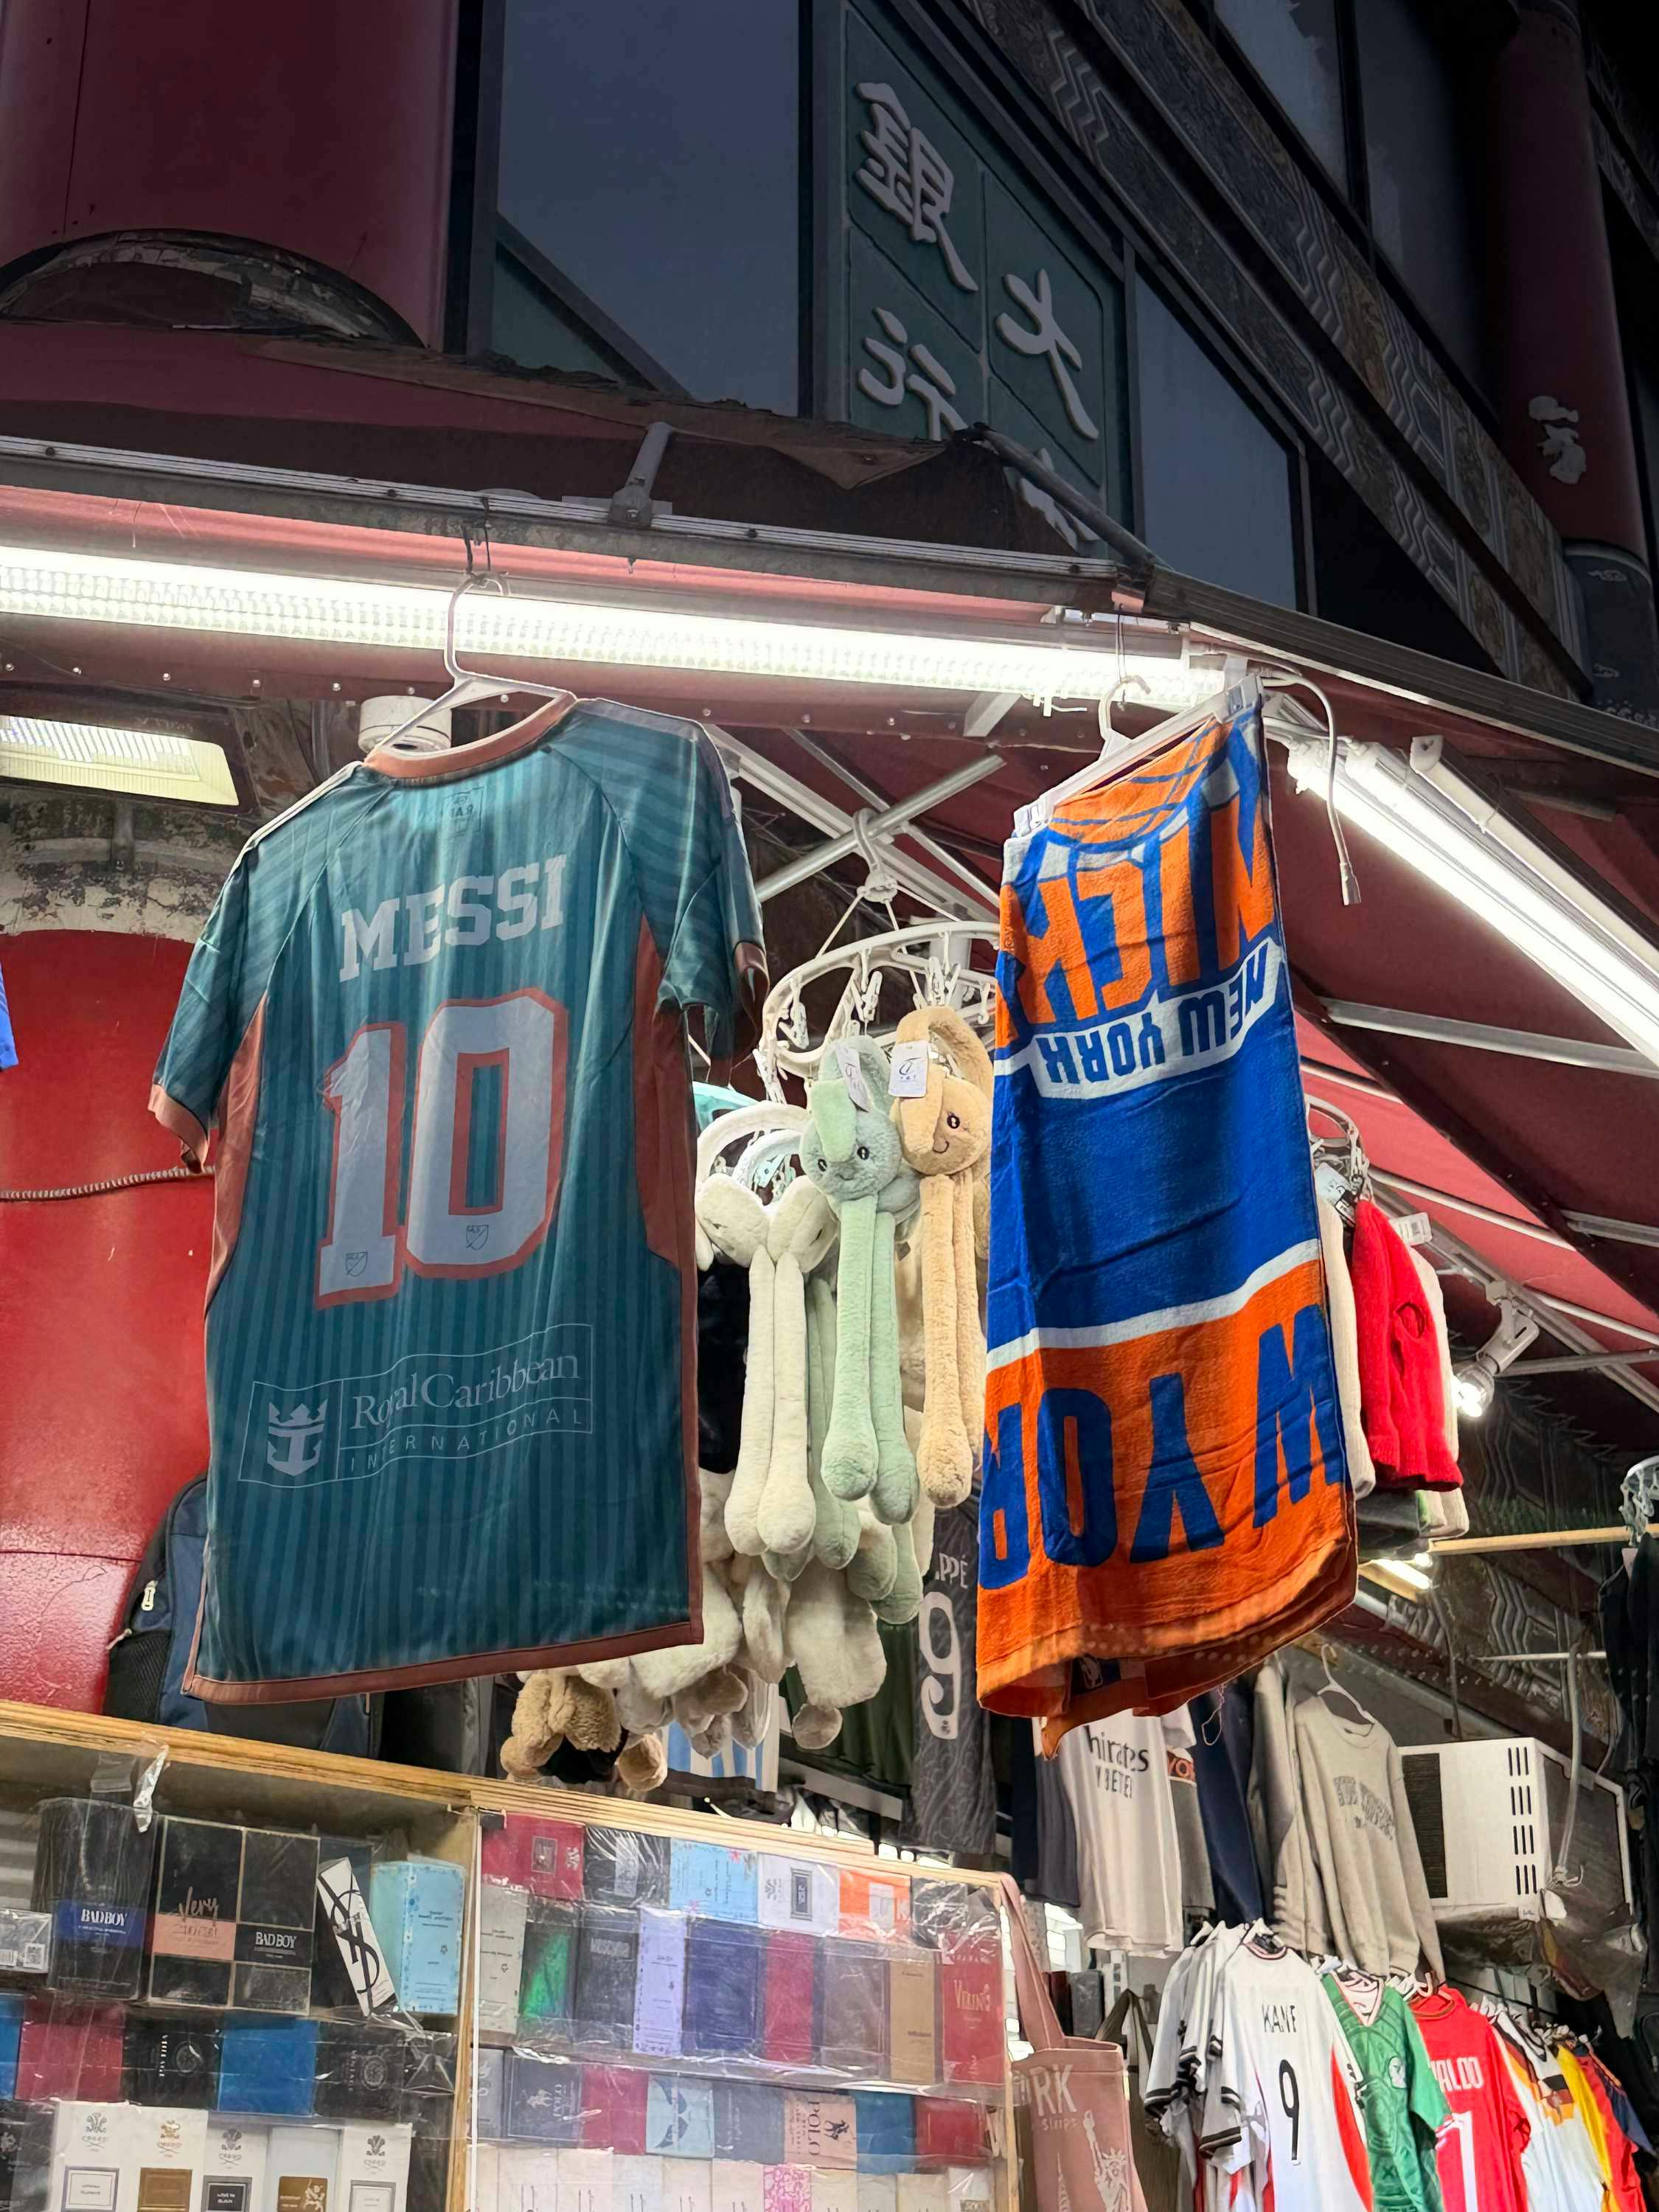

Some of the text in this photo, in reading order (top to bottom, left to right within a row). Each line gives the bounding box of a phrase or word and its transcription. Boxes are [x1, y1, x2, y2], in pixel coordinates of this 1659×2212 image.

[339, 855, 568, 982] MESSI
[1039, 942, 1270, 1085] NEW YORK
[316, 987, 568, 1310] 10
[354, 1354, 581, 1429] Royal Caribbean
[352, 1408, 582, 1472] INTERNATIONAL
[919, 1590, 961, 1740] 9
[178, 1886, 219, 1927] Very
[276, 1933, 296, 1949] BOY
[807, 2100, 821, 2157] POLO
[1279, 2059, 1301, 2163] 9
